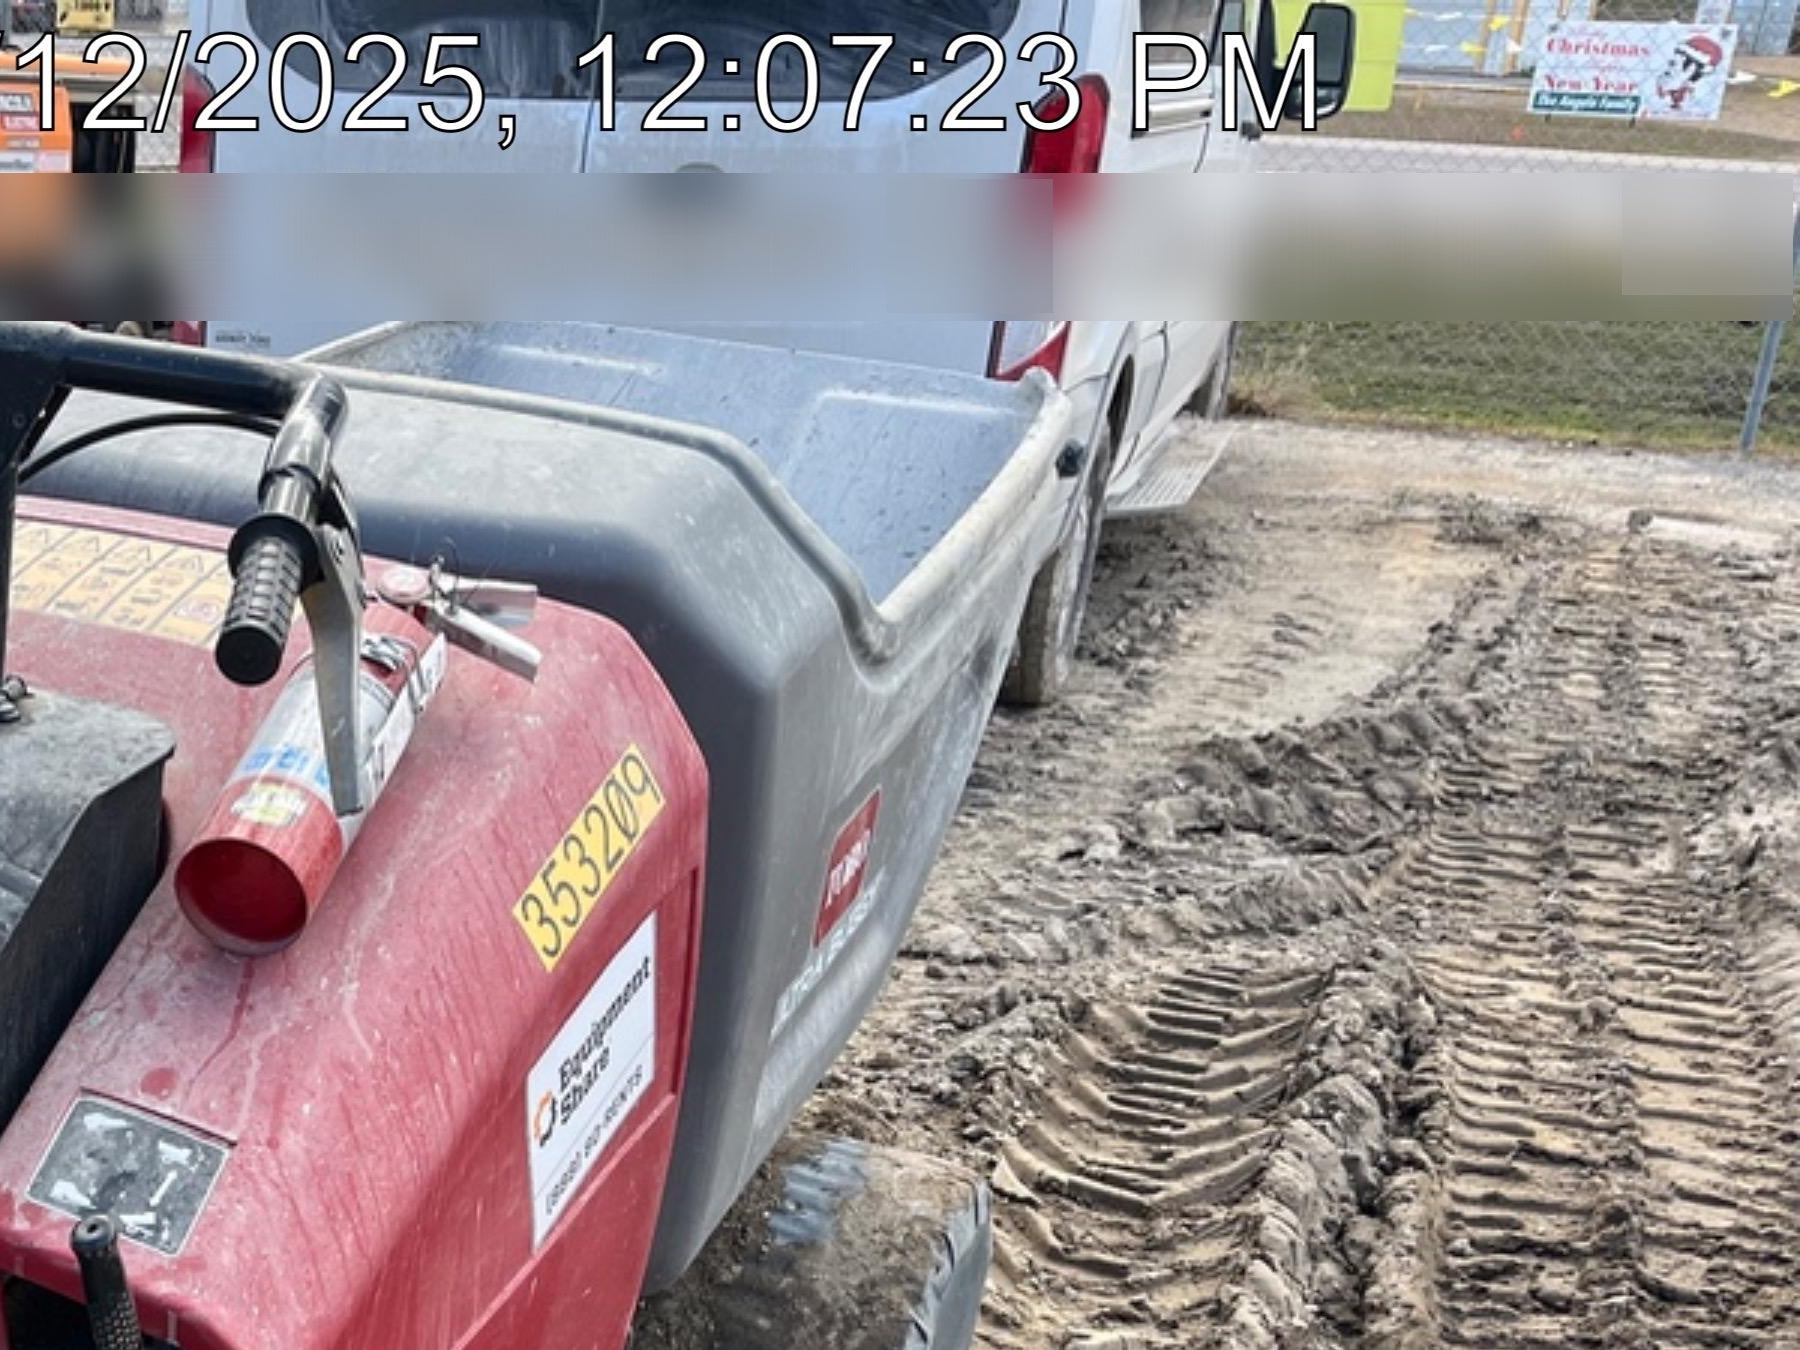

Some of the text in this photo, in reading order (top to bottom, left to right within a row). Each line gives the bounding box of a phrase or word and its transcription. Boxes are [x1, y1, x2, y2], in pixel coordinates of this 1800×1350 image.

[1547, 37, 1650, 57] Christmas
[521, 753, 663, 958] 353209
[558, 955, 651, 1091] Equipment
[560, 1045, 610, 1126] Share
